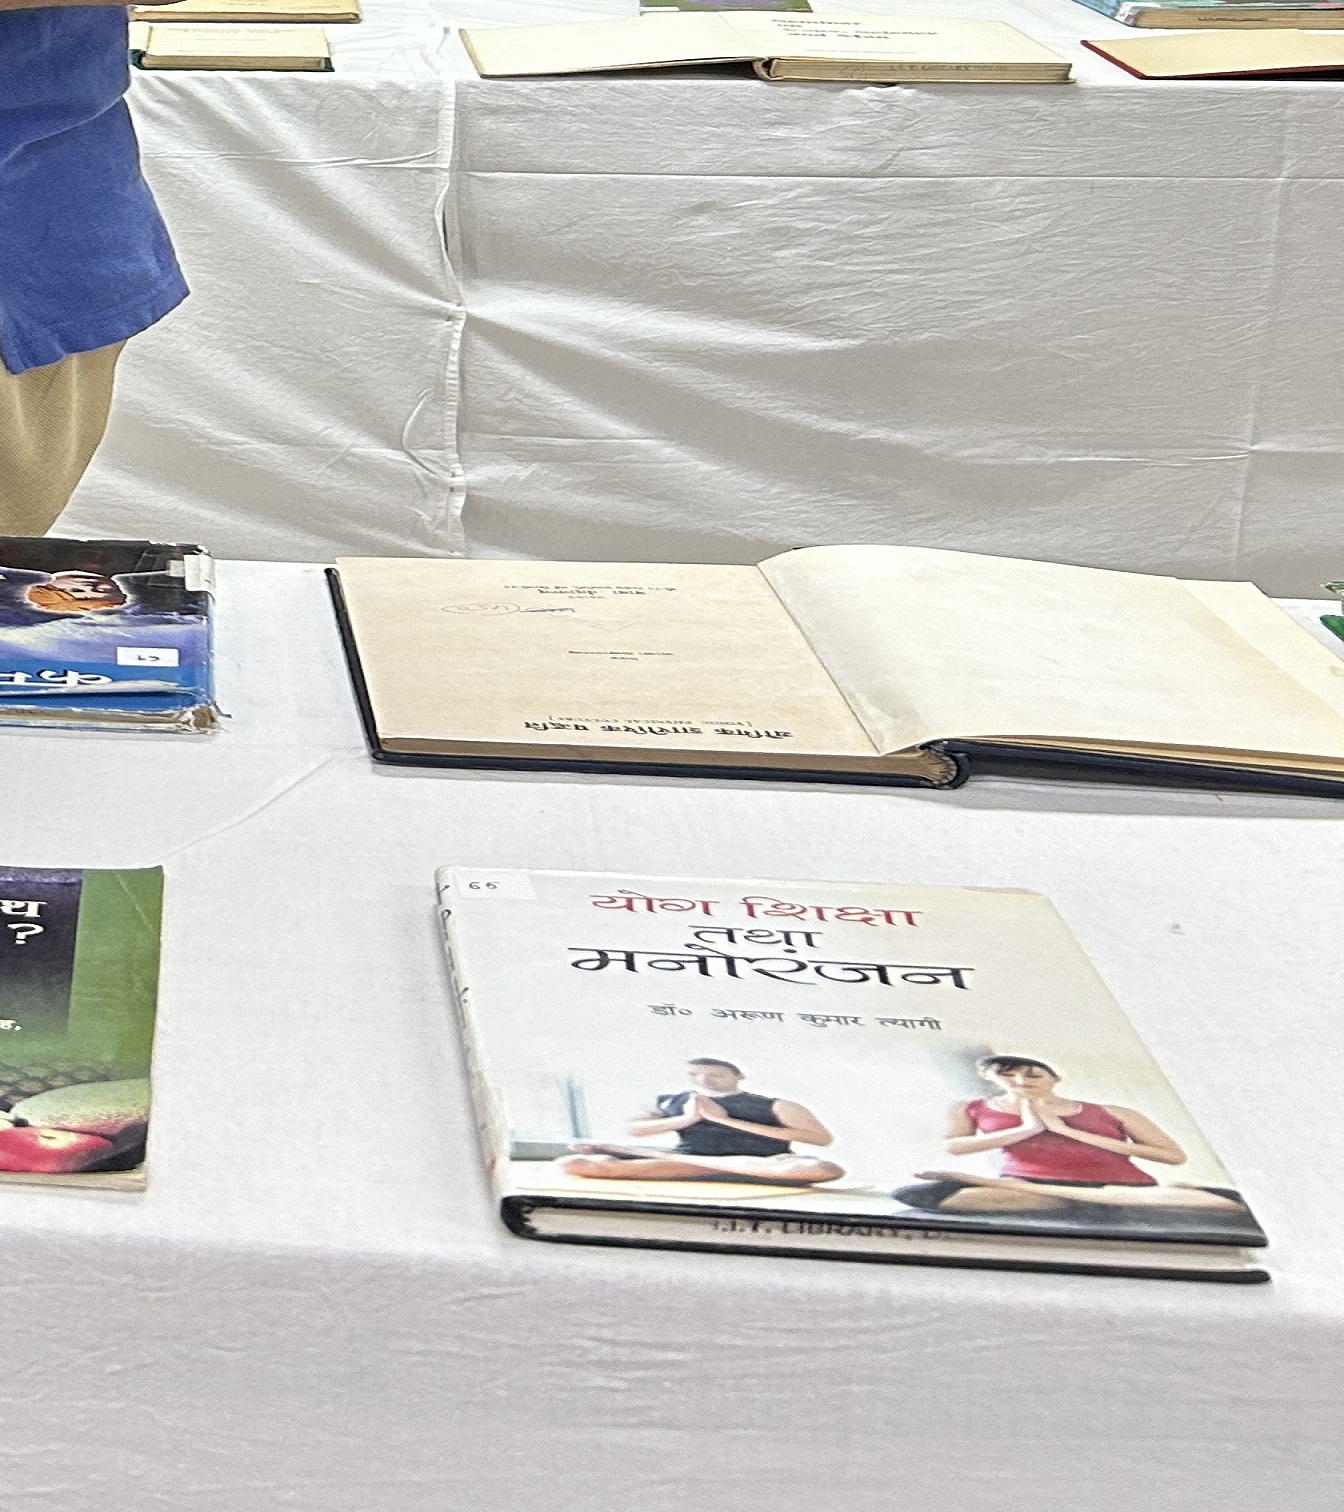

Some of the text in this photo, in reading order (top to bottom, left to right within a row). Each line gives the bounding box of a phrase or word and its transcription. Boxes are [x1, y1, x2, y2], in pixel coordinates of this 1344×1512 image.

[468, 881, 501, 890] 65
[589, 889, 924, 927] योग शिक्षा
[7, 922, 46, 946] ?
[687, 923, 824, 949] तथा
[568, 942, 975, 991] मनोरंजन
[799, 1012, 866, 1028] कुमार
[876, 1015, 942, 1031] त्यागी
